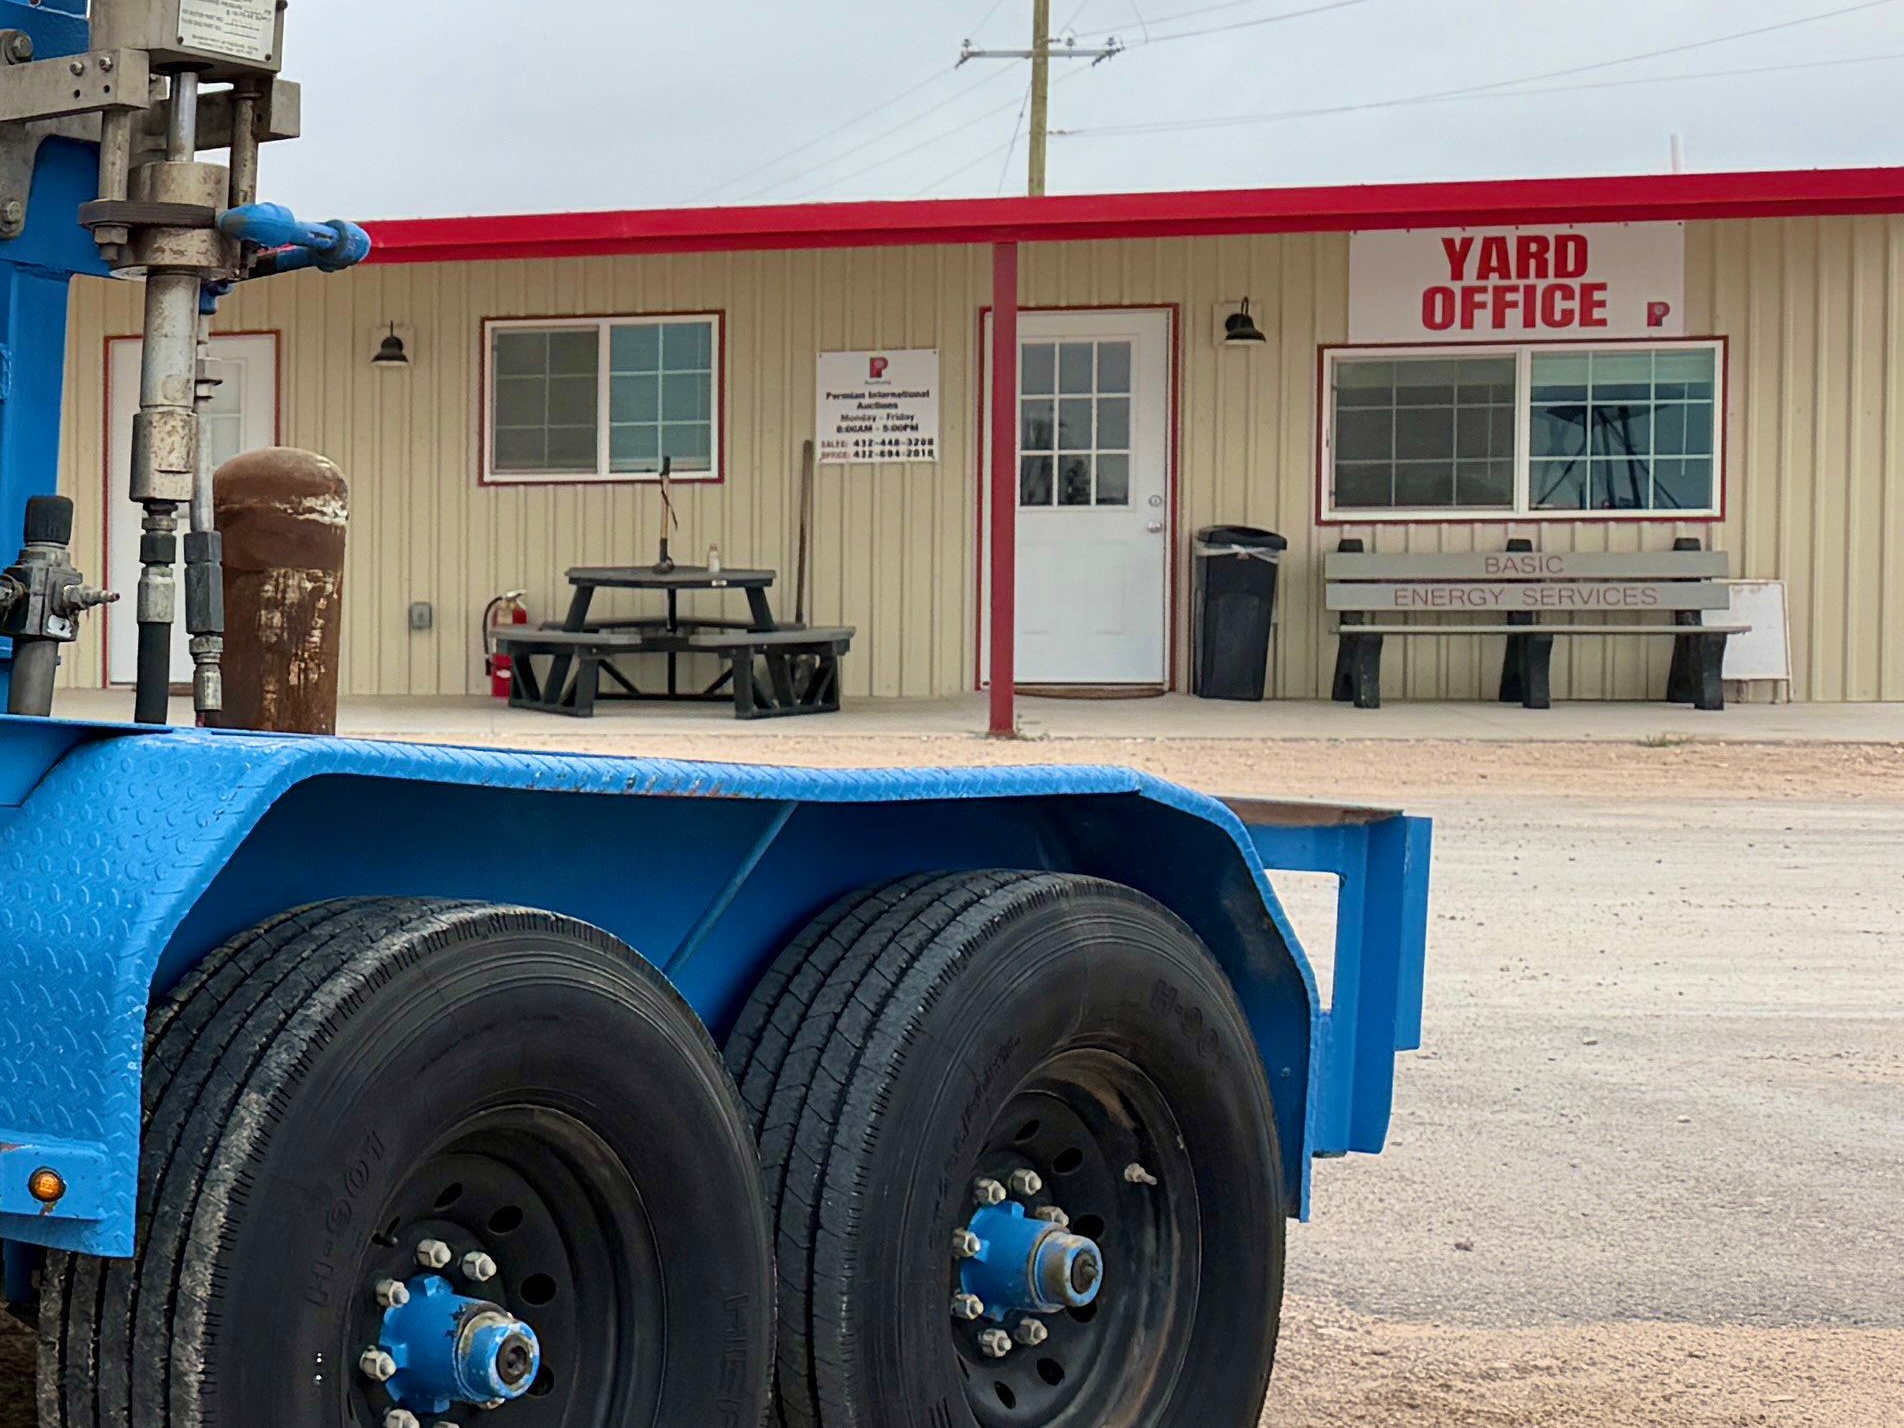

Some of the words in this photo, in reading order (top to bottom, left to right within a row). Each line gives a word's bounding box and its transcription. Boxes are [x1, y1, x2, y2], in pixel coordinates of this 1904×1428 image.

[1441, 234, 1588, 281] YARD
[1422, 282, 1608, 331] OFFICE
[826, 391, 866, 400] Permian
[868, 389, 930, 400] International
[857, 401, 898, 410] Auctions
[840, 413, 877, 423] Monday
[886, 412, 915, 422] Friday
[1484, 555, 1564, 575] BASIC
[1394, 586, 1505, 607] ENERGY
[1521, 585, 1659, 607] SERVICES
[303, 1129, 385, 1307] H-901
